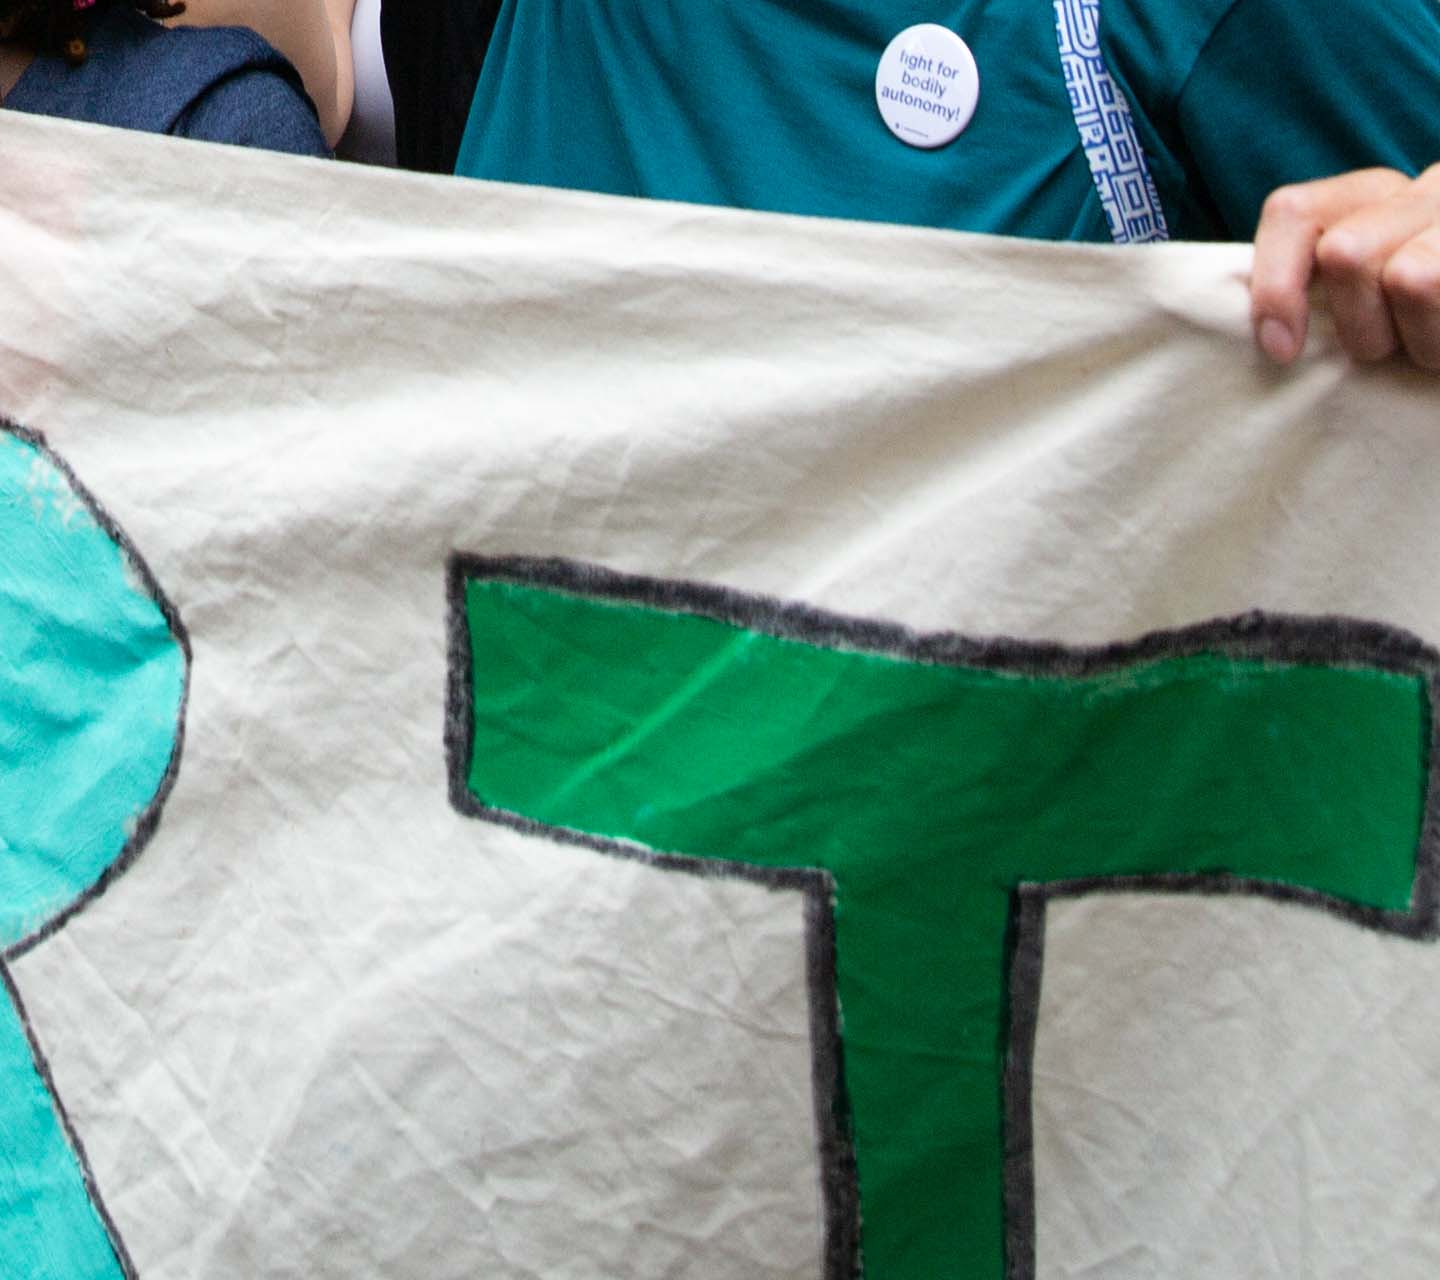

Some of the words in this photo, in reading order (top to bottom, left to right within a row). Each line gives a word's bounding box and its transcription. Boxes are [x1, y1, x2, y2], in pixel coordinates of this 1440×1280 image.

[901, 70, 947, 100] bodily
[936, 60, 960, 80] for
[881, 84, 962, 123] autonomy!
